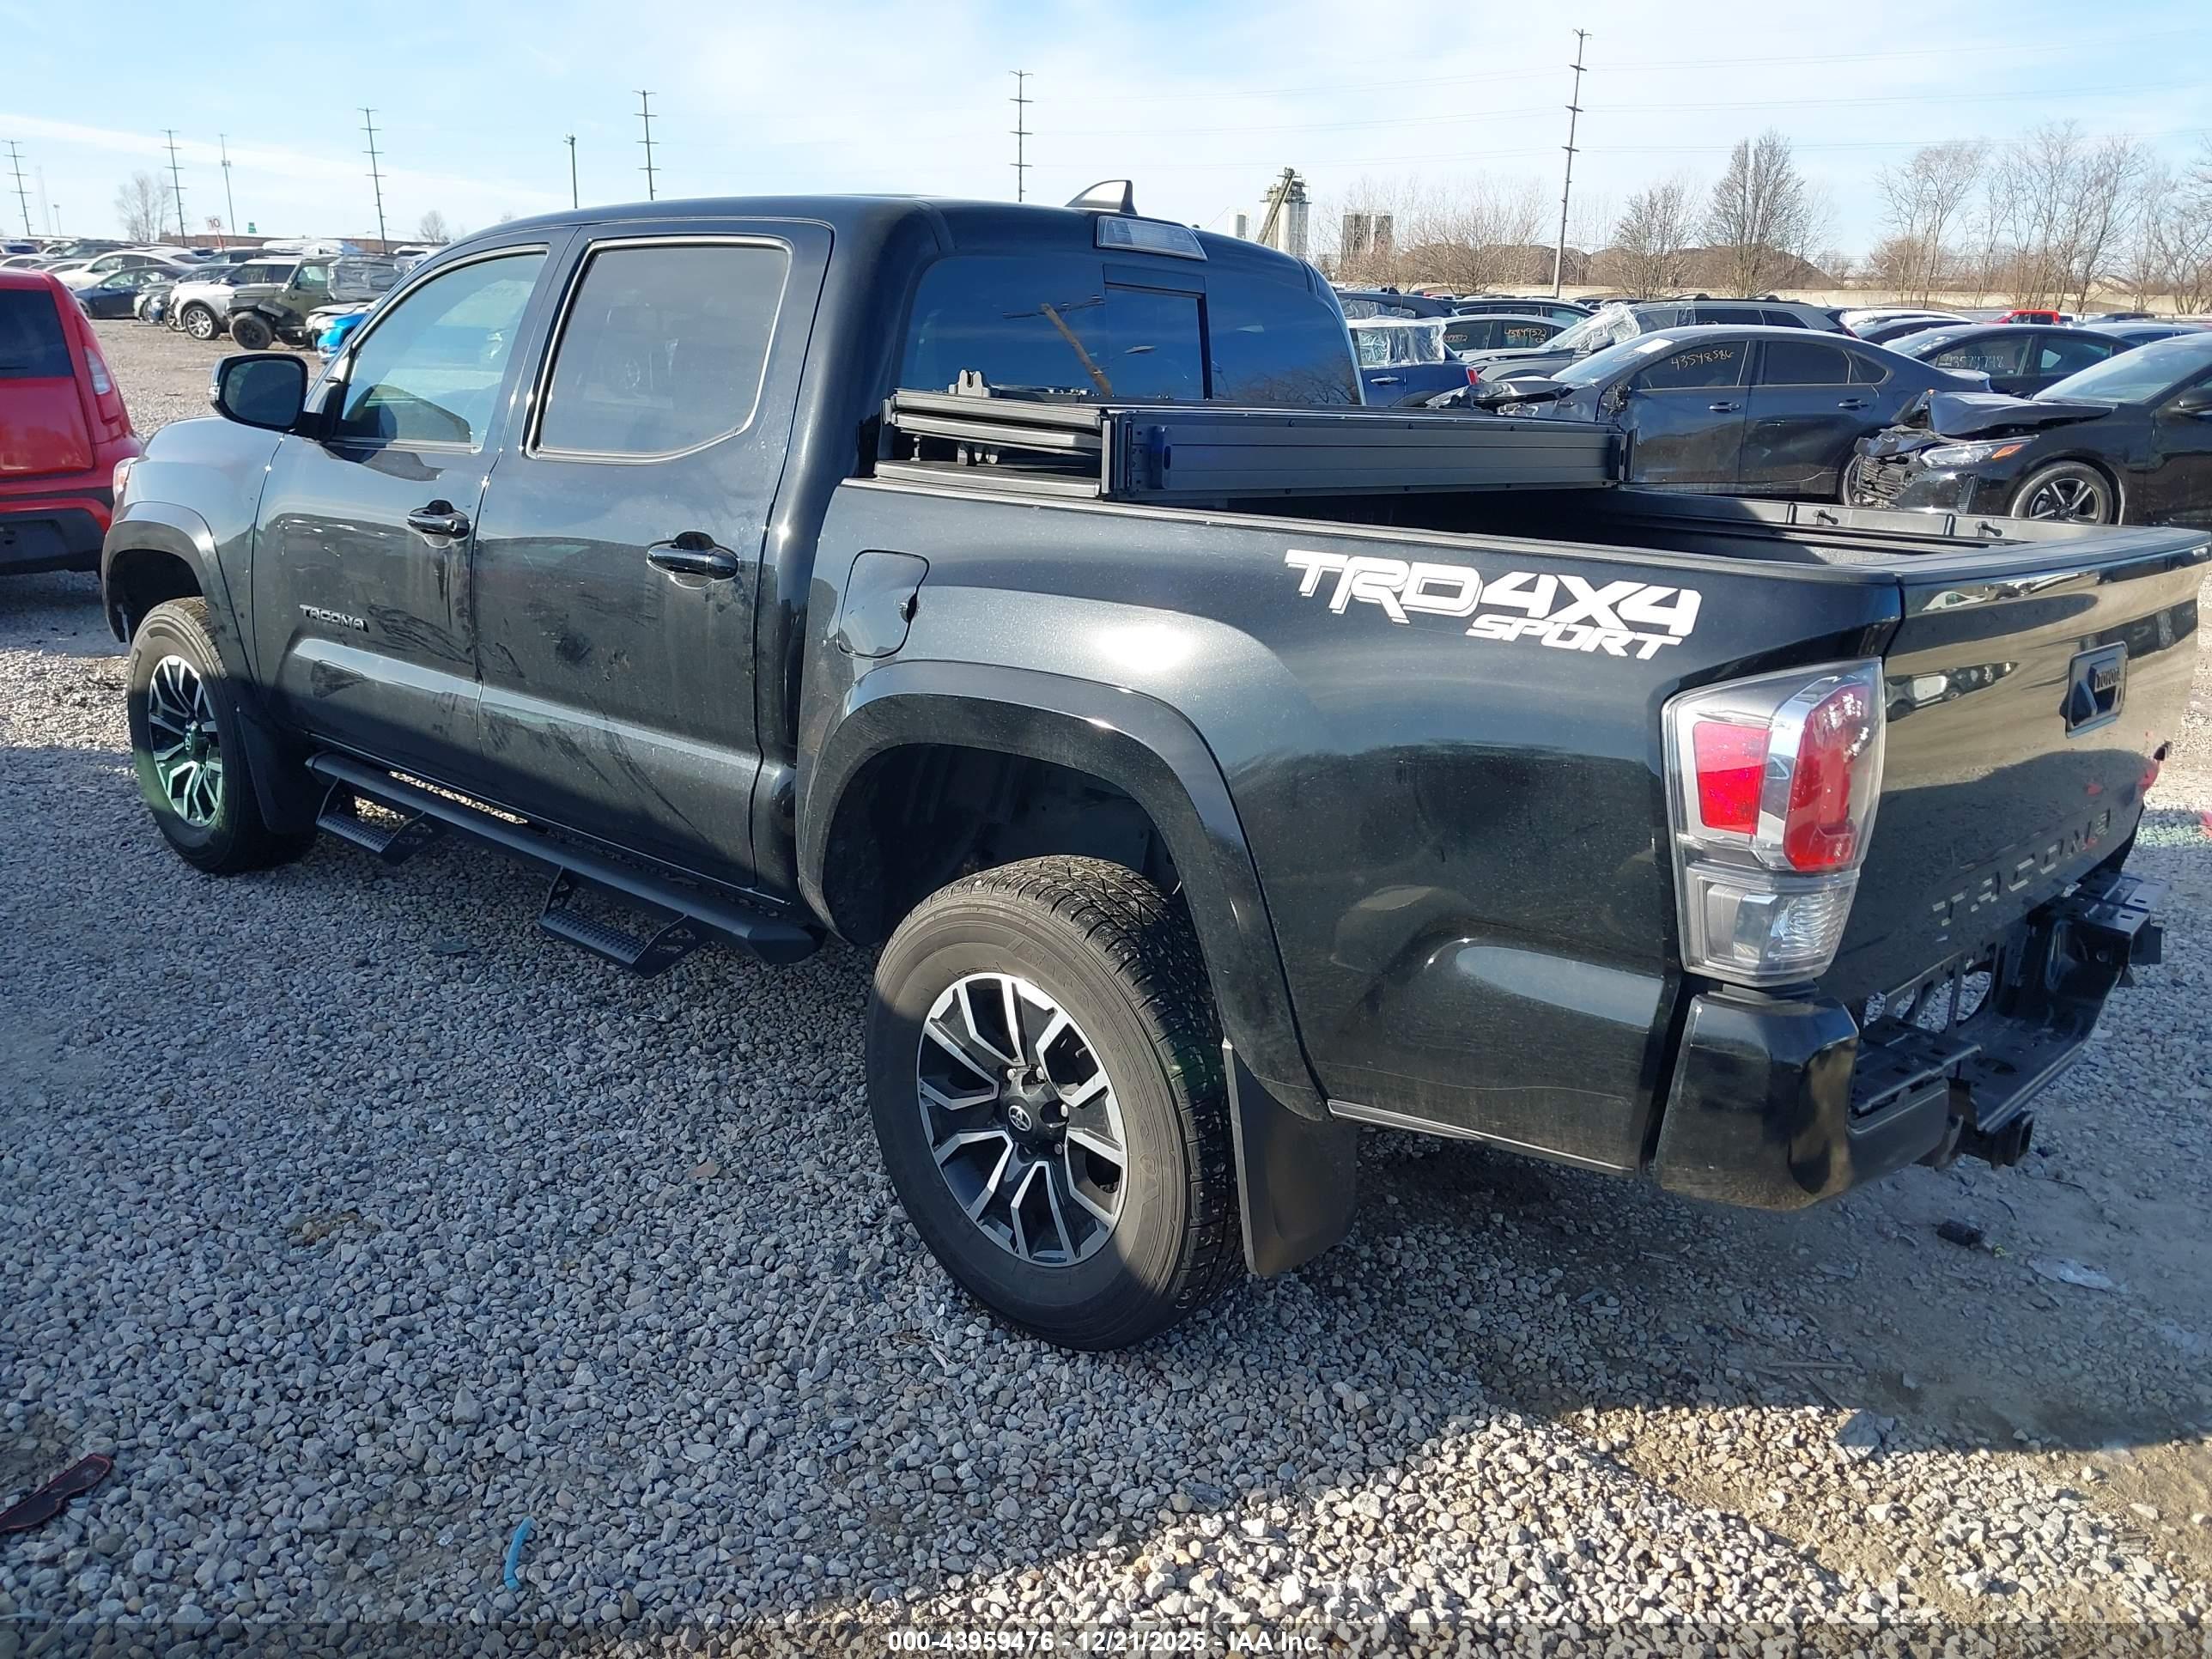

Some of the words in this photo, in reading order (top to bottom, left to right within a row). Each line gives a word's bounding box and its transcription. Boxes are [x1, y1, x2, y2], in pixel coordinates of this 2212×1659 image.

[207, 217, 221, 228] 10
[1284, 549, 1484, 625] TRD
[299, 604, 369, 634] TACOMA
[1465, 613, 1683, 659] SPORT
[1932, 808, 2111, 927] TACOMA
